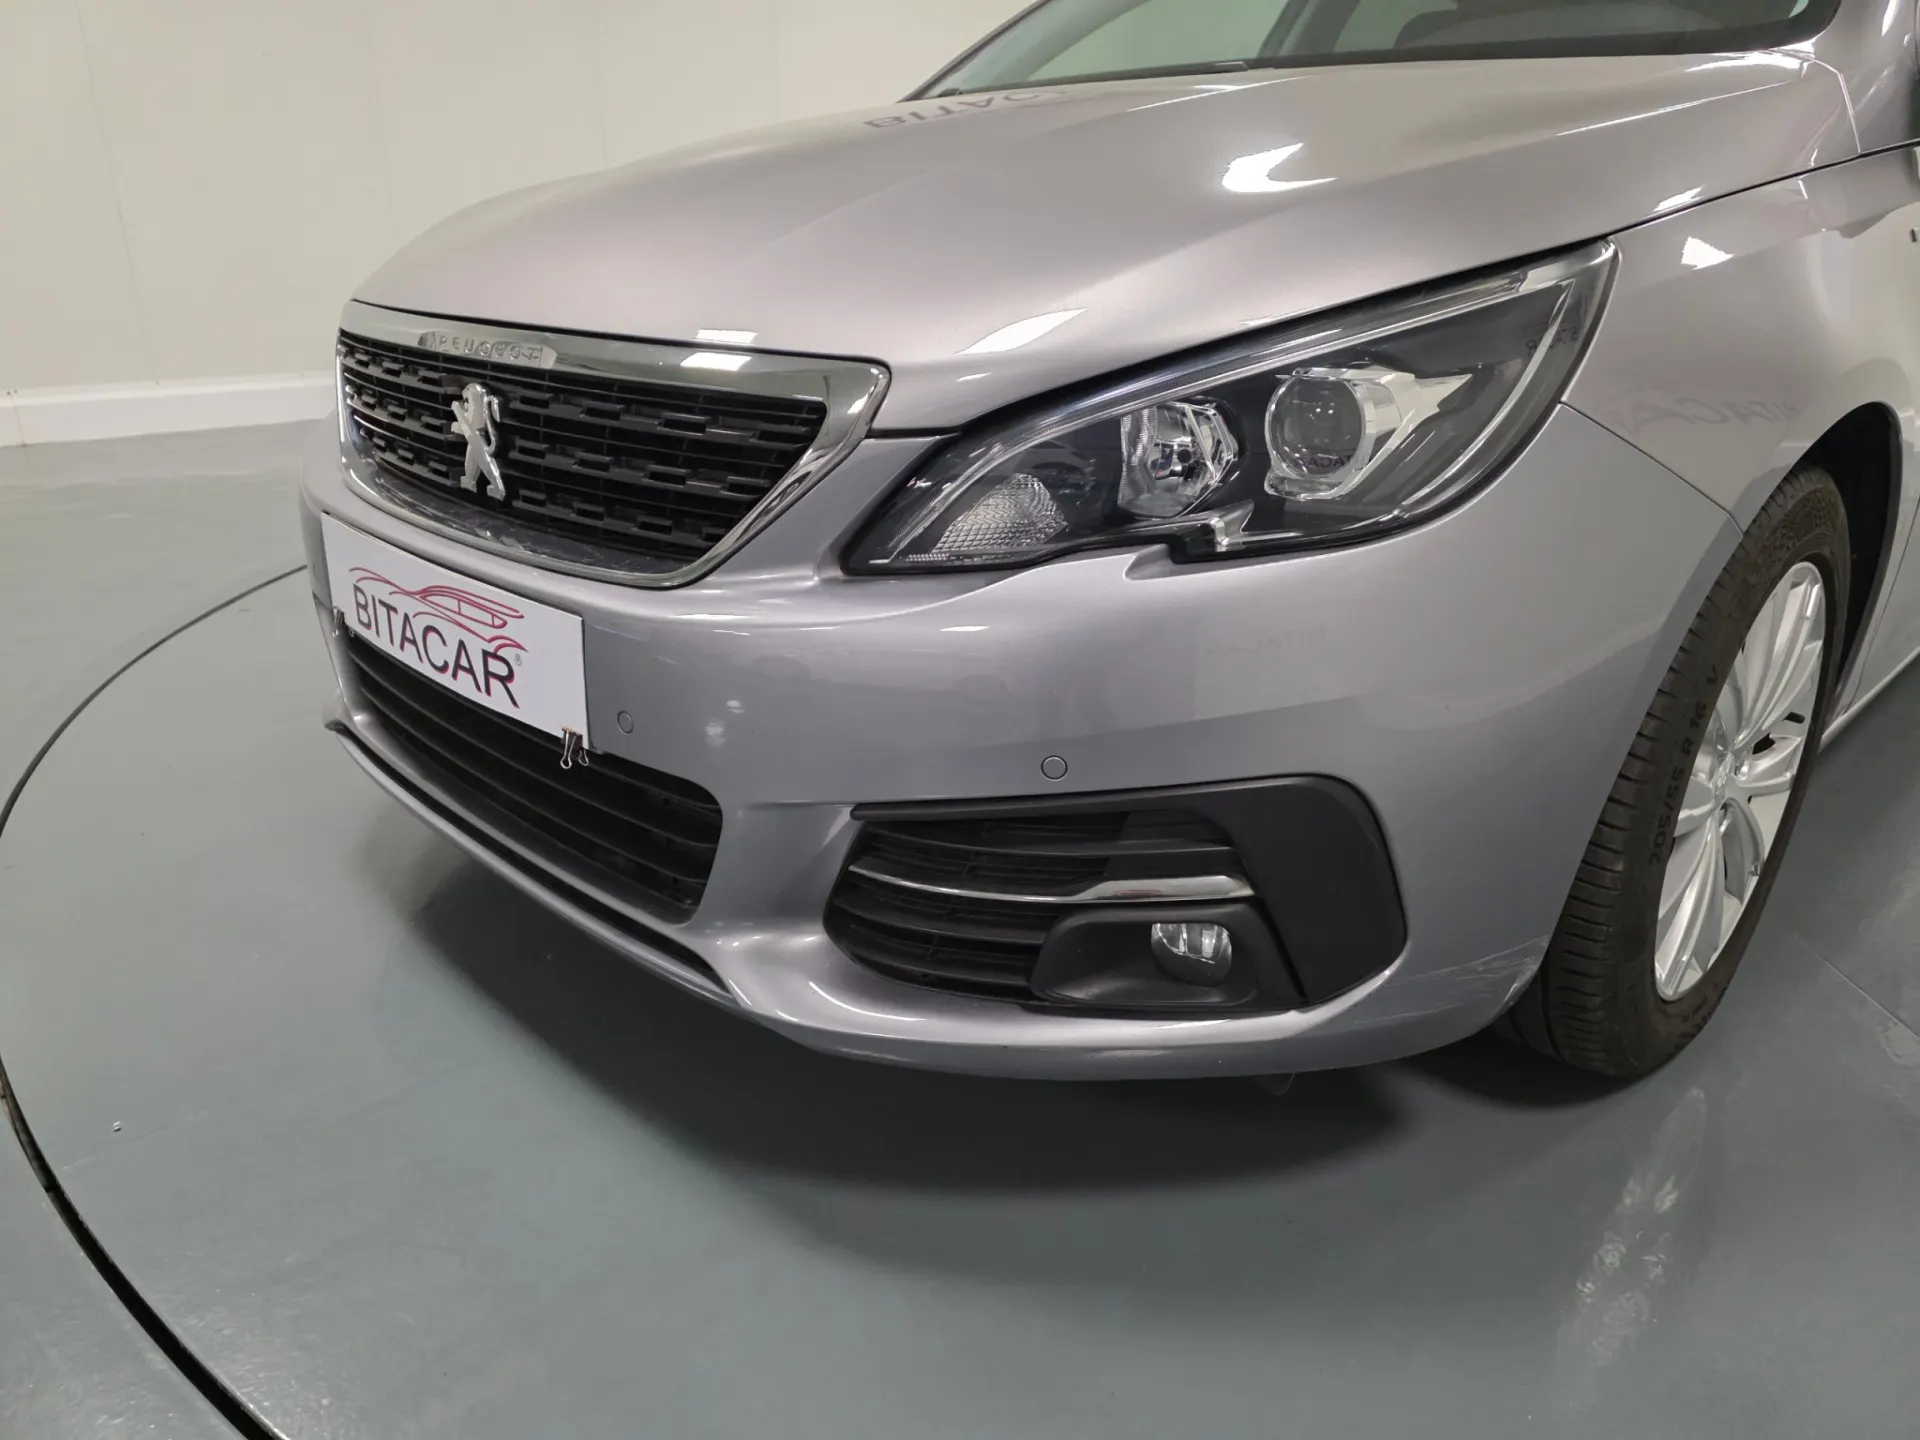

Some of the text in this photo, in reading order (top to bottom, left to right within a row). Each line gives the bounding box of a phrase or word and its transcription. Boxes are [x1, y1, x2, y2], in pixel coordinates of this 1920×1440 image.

[352, 583, 520, 709] BITACAR
[1649, 766, 1685, 865] 205/55
[1682, 736, 1694, 756] R
[1689, 702, 1708, 733] 16
